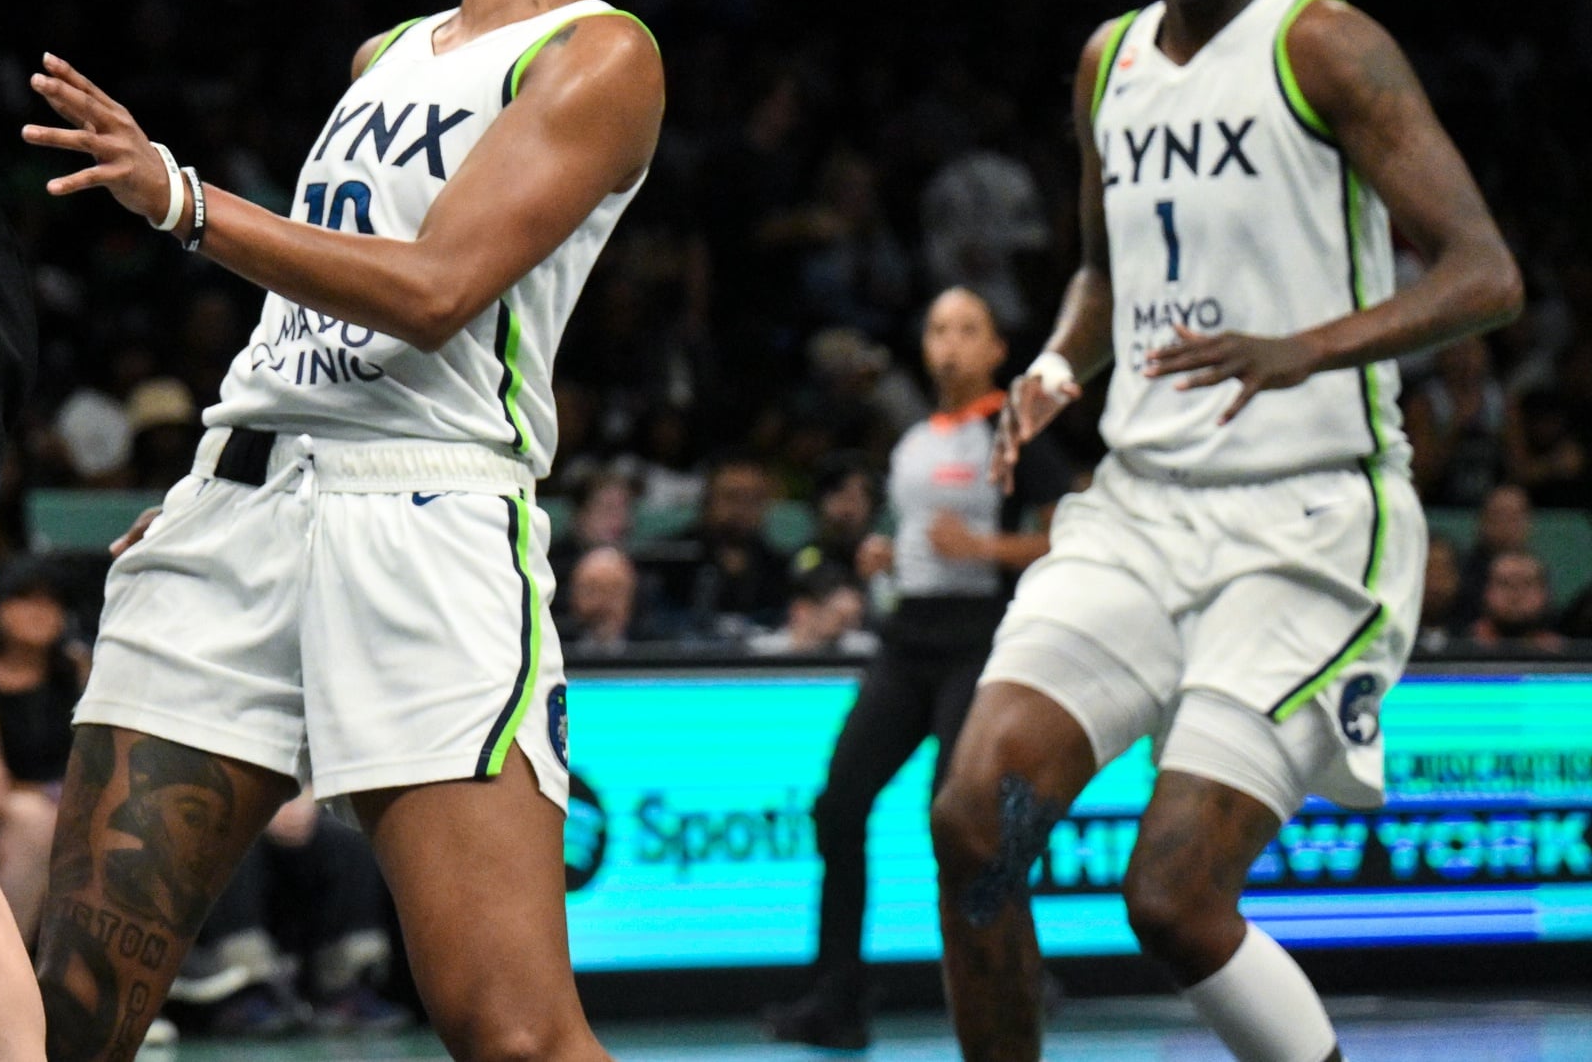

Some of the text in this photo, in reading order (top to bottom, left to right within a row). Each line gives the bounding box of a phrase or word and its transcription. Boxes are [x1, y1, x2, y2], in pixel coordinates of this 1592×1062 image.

[313, 101, 475, 180] YNX
[1103, 117, 1259, 188] LYNX
[1155, 201, 1181, 282] 1
[1133, 297, 1223, 332] MAYO
[635, 788, 816, 872] Spoti
